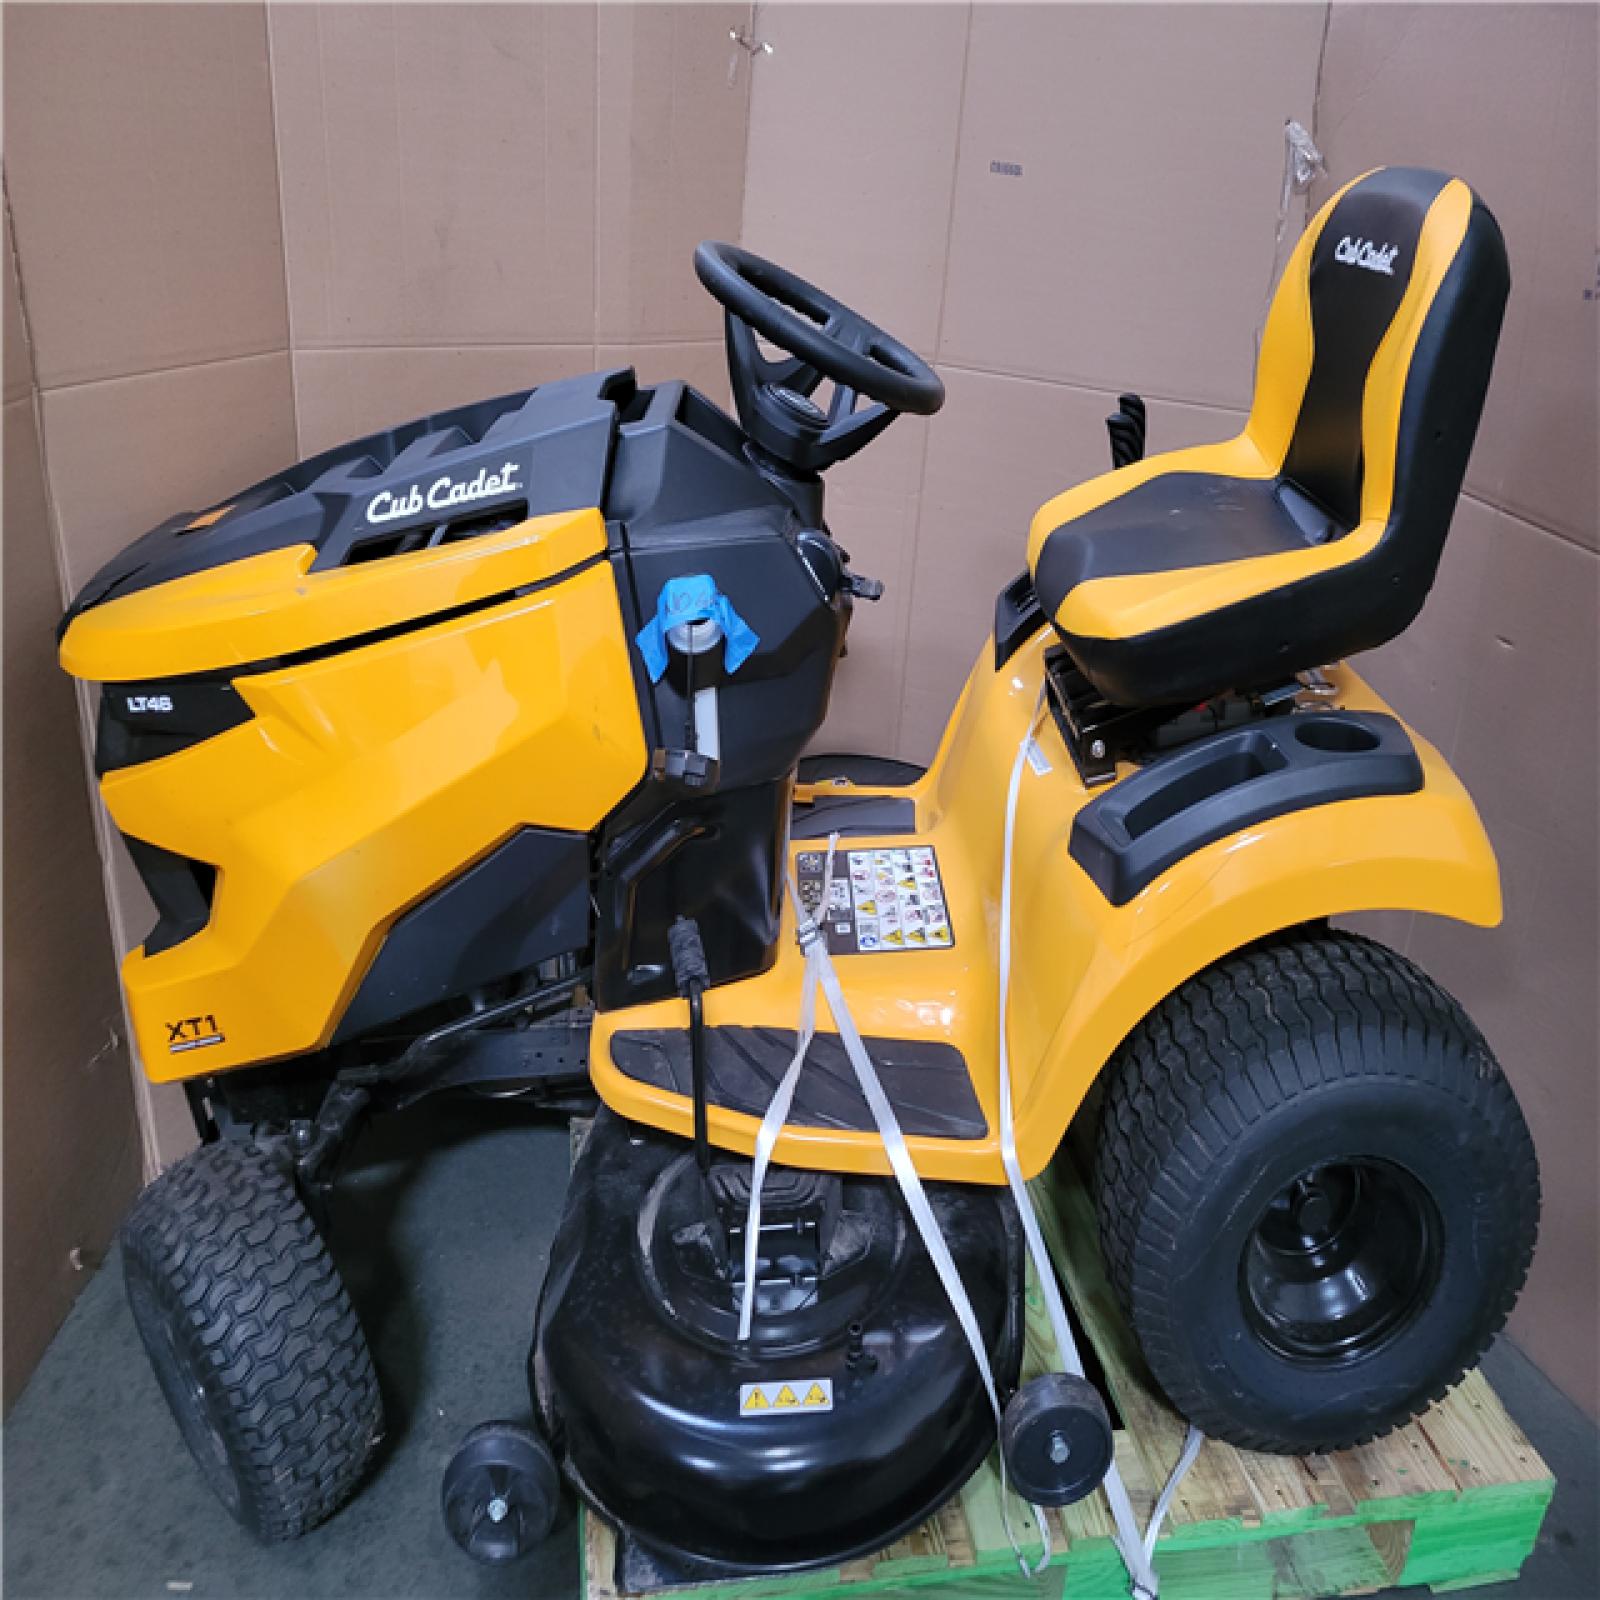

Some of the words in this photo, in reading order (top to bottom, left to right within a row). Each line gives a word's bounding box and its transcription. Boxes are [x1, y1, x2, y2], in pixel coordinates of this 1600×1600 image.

[1334, 235, 1362, 265] Cub
[367, 485, 423, 523] Cub
[427, 462, 520, 508] Cadet
[165, 1015, 217, 1041] XT1
